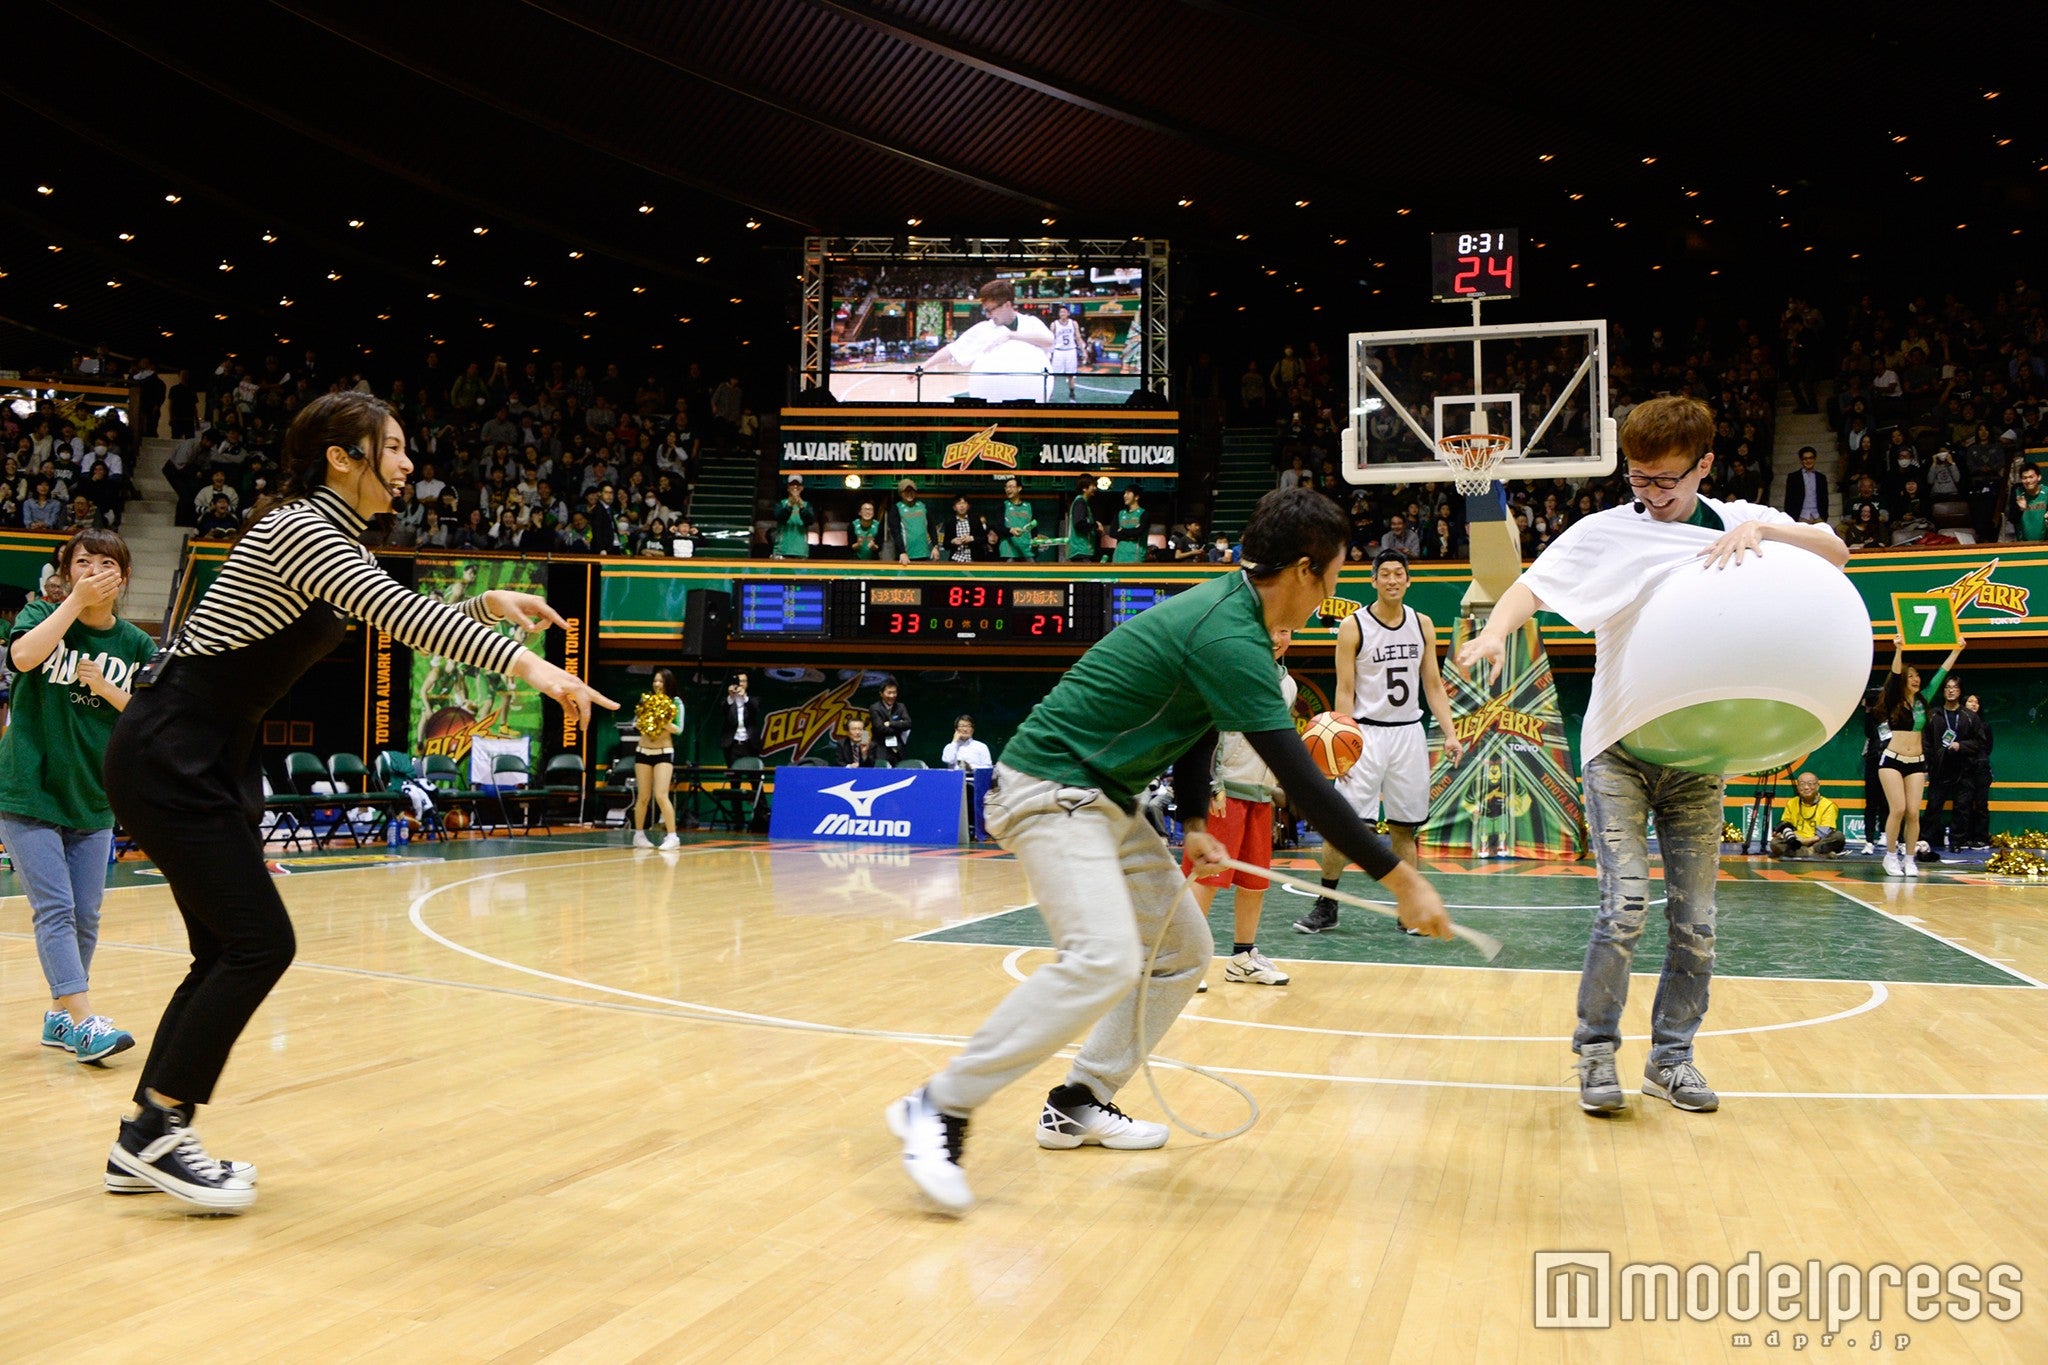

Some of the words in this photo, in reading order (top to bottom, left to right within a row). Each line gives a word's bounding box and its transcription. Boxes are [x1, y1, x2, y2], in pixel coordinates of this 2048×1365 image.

[1458, 233, 1504, 254] 8:31
[1454, 255, 1513, 293] 24
[783, 442, 851, 461] ALVARK
[863, 442, 917, 462] TOKYO
[1040, 443, 1109, 464] ALVARK
[1118, 445, 1174, 465] TOKYO
[949, 587, 1003, 607] 8:31
[890, 613, 920, 633] 33
[1031, 615, 1063, 634] 27
[1912, 605, 1938, 637] 7
[1989, 617, 2021, 625] TOKYO
[1372, 643, 1419, 663] 山王工高
[377, 653, 391, 697] ALVARK
[1386, 667, 1410, 707] 5
[69, 692, 101, 708] OKYO
[376, 700, 389, 744] TOYOTA
[1509, 743, 1539, 753] TOKYO
[1540, 772, 1569, 804] TOYOTA
[813, 813, 912, 838] MIZUNO
